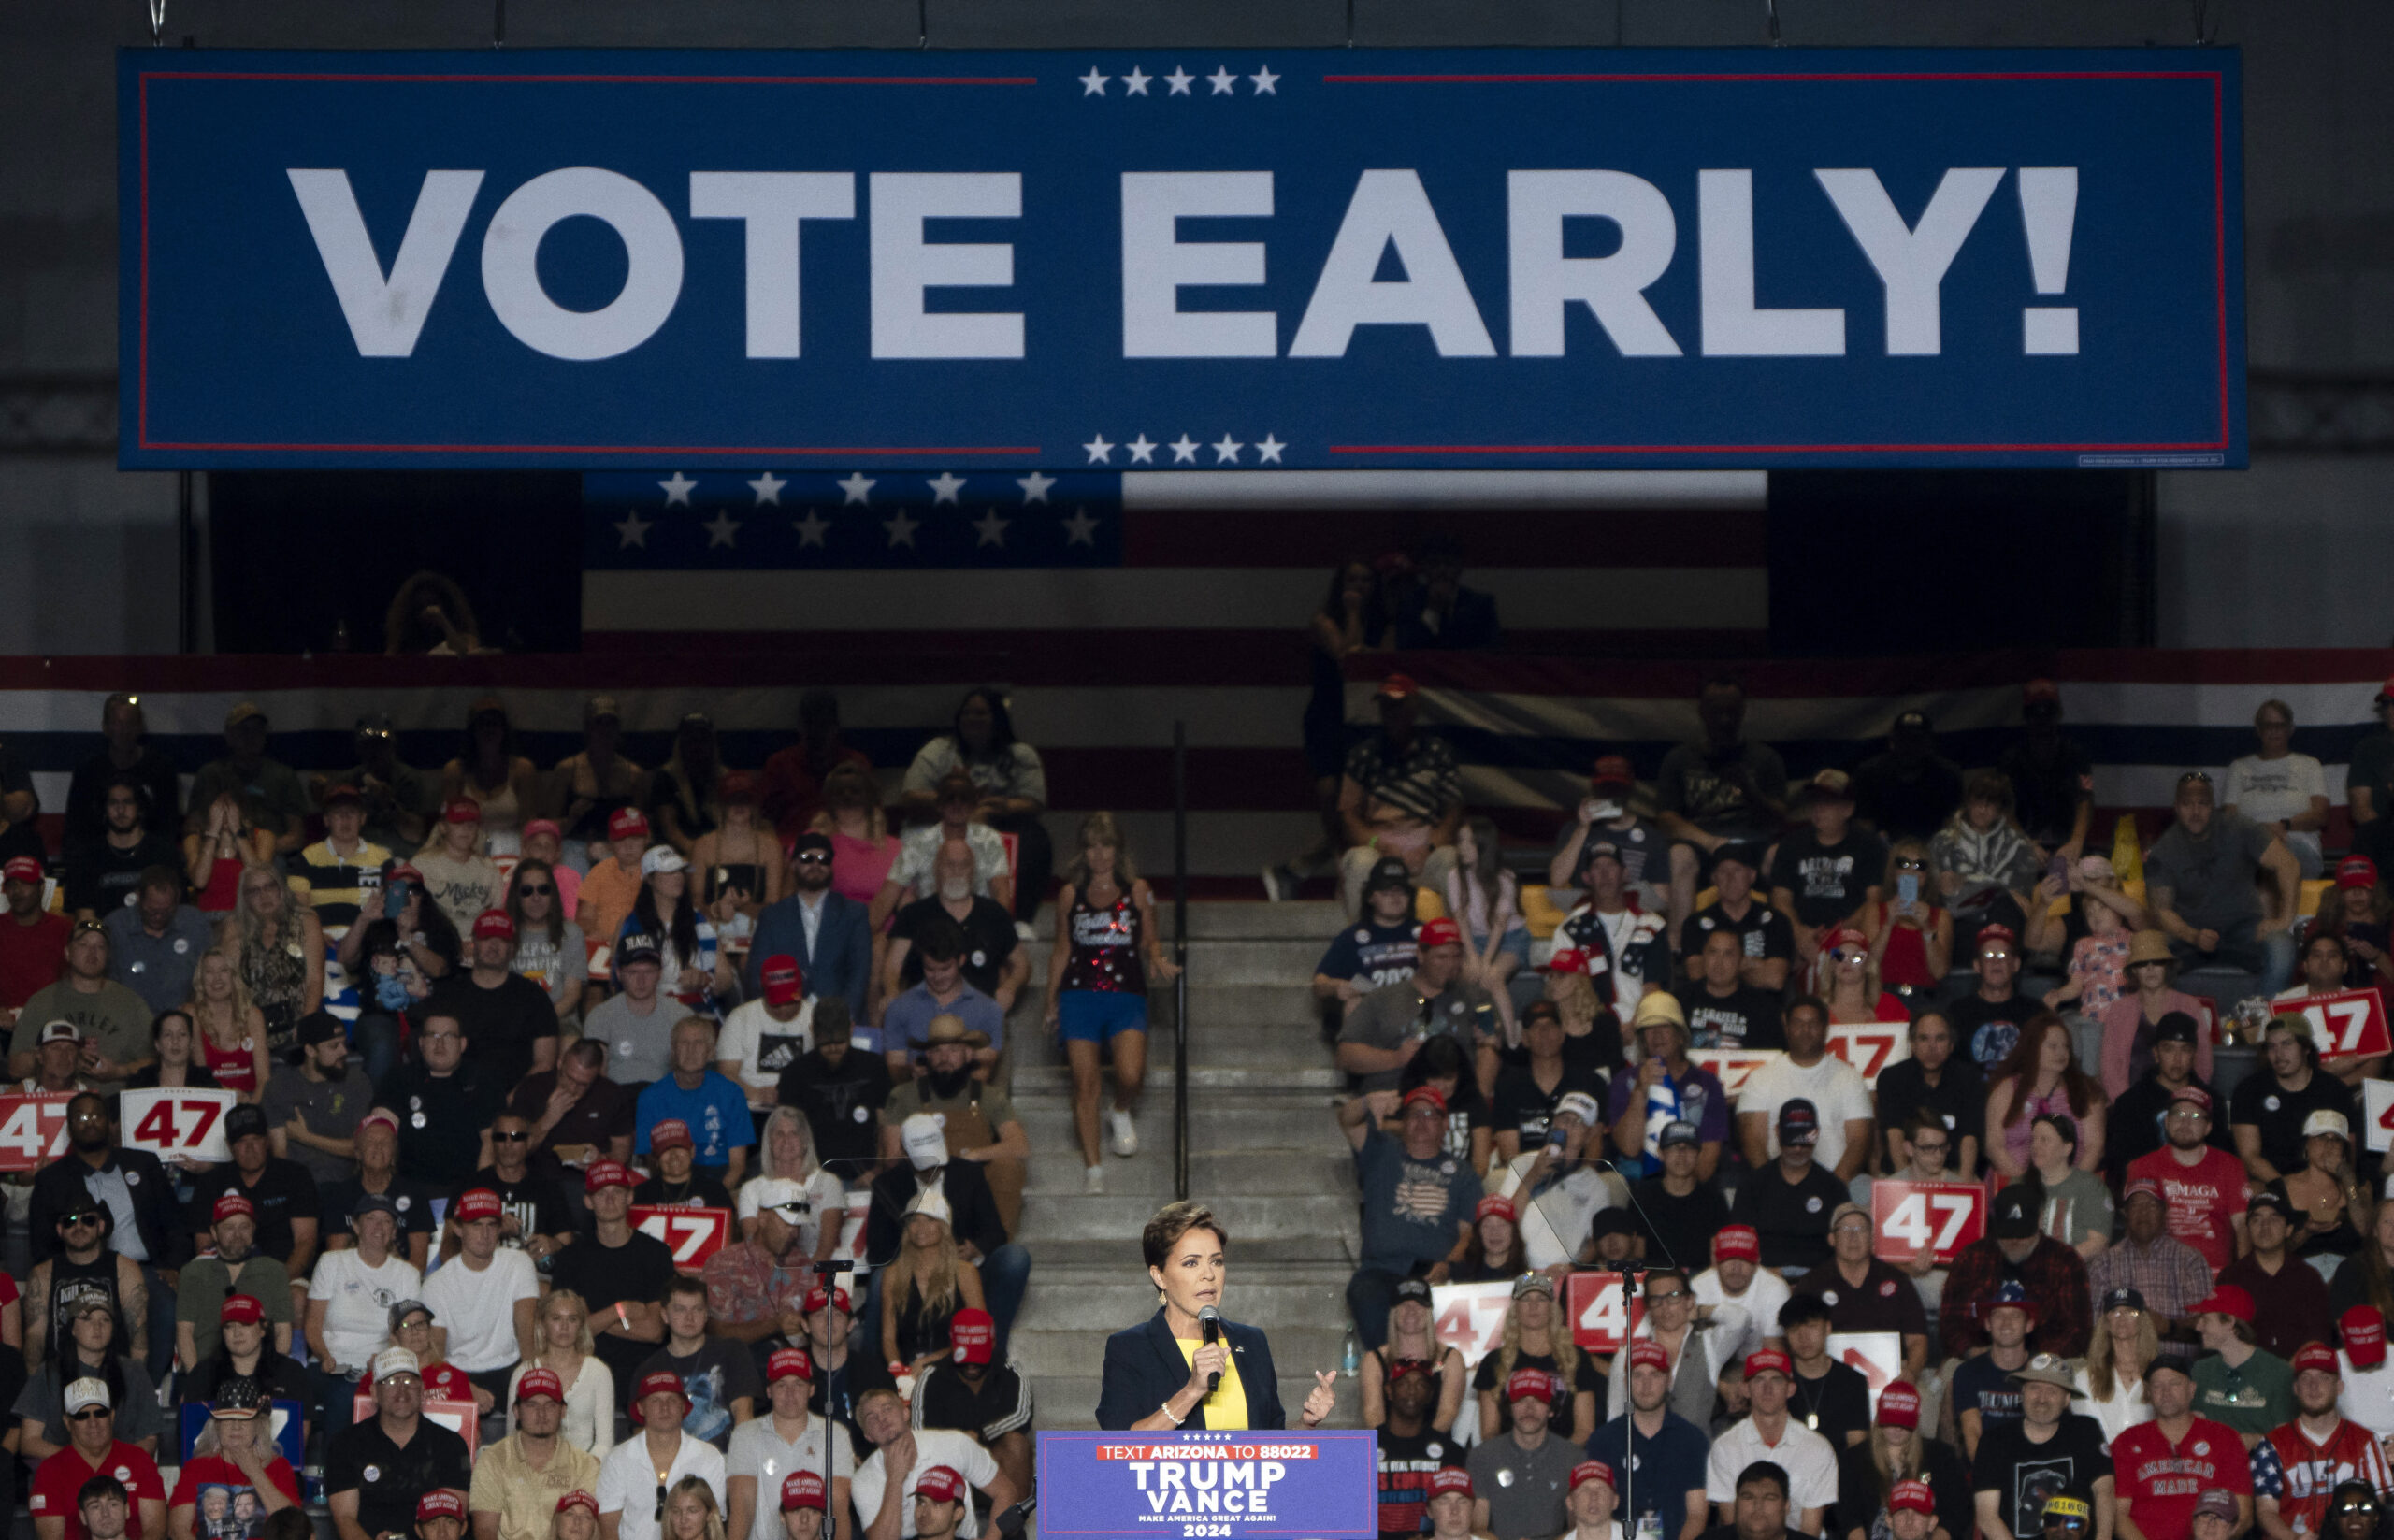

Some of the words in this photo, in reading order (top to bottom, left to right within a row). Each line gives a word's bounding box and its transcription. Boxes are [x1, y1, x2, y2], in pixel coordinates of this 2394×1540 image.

[286, 166, 1026, 361] VOTE
[1121, 166, 2081, 361] EARLY!
[135, 1100, 222, 1148] 47
[1882, 1193, 1973, 1250] 47
[1436, 1296, 1513, 1352] 47
[1103, 1446, 1145, 1460] TEXT
[1150, 1446, 1228, 1459] ARIZONA
[1234, 1446, 1255, 1459] TO
[1260, 1446, 1311, 1459] 88022
[1129, 1461, 1286, 1490] TRUMP
[2137, 1459, 2216, 1482] AMERICAN
[786, 1480, 800, 1489] MAKE
[801, 1478, 822, 1488] AMERICA
[788, 1488, 805, 1497] GREAT
[806, 1488, 821, 1496] AGAIN
[2153, 1479, 2198, 1496] MADE
[423, 1496, 438, 1504] MAKE
[439, 1494, 459, 1504] AMERICA
[425, 1502, 441, 1511] GREAT
[442, 1502, 457, 1511] AGAIN
[1147, 1490, 1268, 1513] VANCE
[1183, 1524, 1232, 1537] 2024
